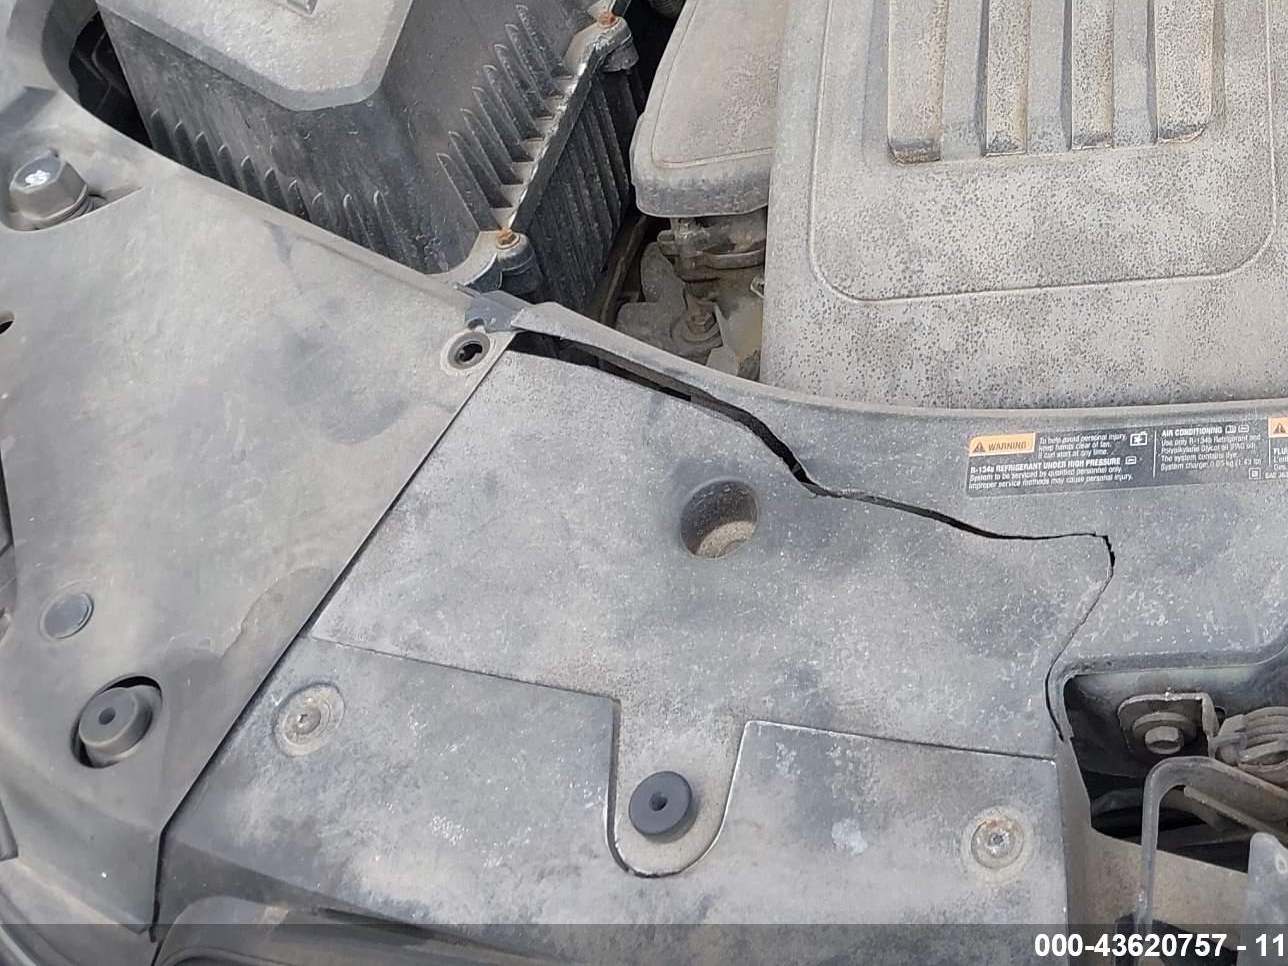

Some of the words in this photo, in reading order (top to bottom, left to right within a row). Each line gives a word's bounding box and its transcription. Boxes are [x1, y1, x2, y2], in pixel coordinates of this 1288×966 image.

[1161, 429, 1173, 437] AIR
[1174, 426, 1223, 436] CONDITIONING
[988, 441, 1027, 451] WARNING
[995, 461, 1042, 473] REFRIGERANT
[1043, 460, 1067, 469] UNDER
[1067, 459, 1084, 467] HIGH
[1085, 457, 1121, 467] PRESSURE
[1050, 477, 1065, 485] may
[1066, 476, 1085, 484] cause
[1085, 474, 1113, 484] personal
